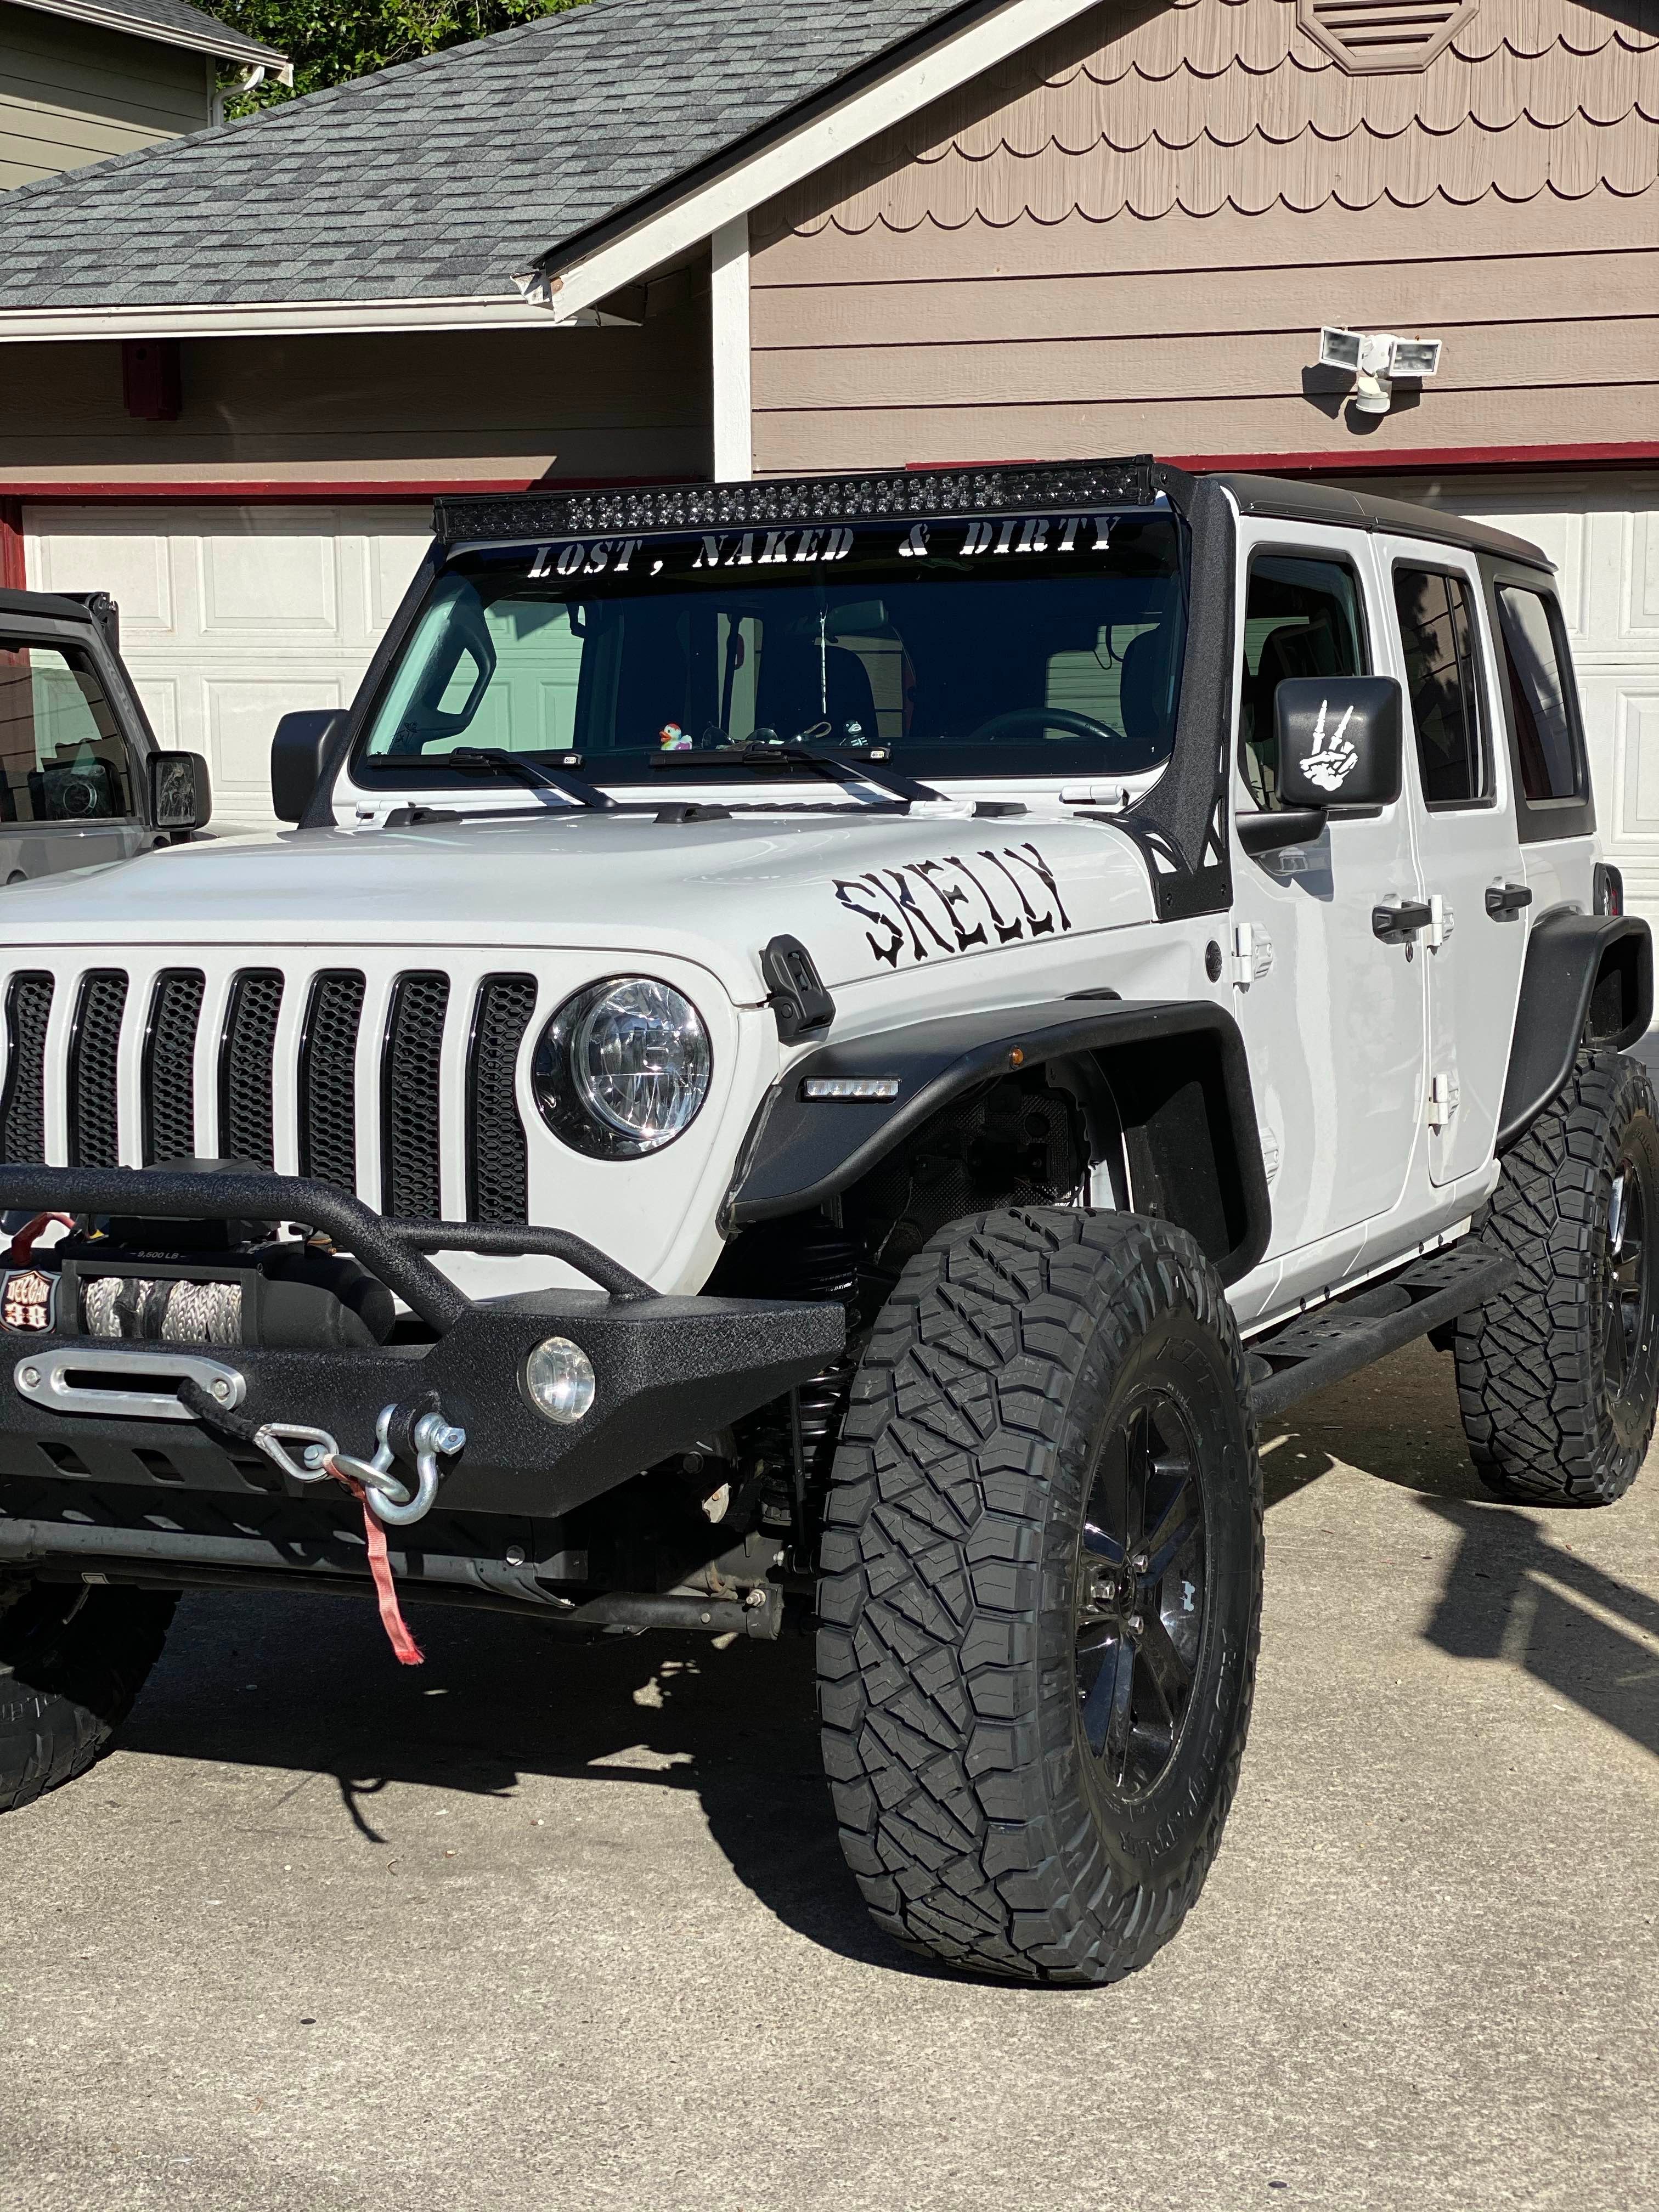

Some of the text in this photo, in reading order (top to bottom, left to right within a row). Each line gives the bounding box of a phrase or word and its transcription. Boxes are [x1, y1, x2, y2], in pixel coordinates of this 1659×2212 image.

[692, 528, 854, 568] NAKED
[899, 523, 930, 557] &
[959, 516, 1121, 555] DIRTY
[832, 842, 1072, 968] SKELLY
[7, 1274, 50, 1305] DEEGAN
[4, 1302, 48, 1329] 38
